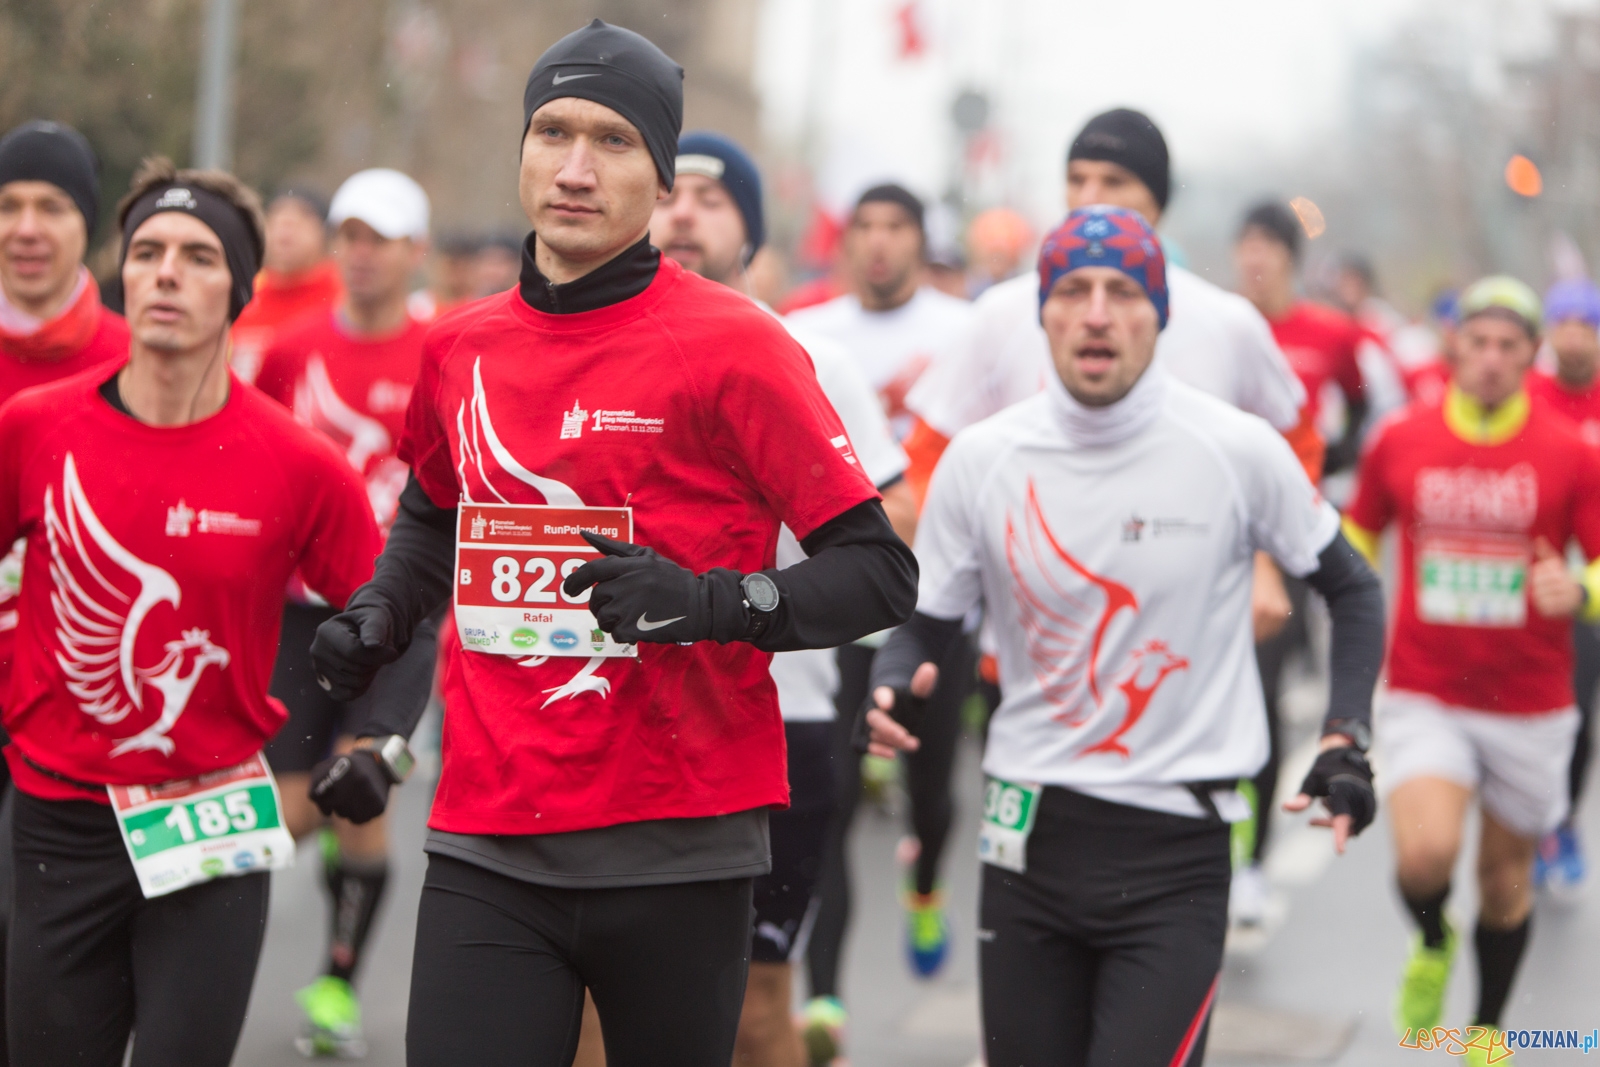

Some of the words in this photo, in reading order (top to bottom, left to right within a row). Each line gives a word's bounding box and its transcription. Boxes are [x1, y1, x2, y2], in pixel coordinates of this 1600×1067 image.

[459, 568, 472, 585] B
[523, 612, 554, 623] Rafał
[464, 628, 486, 637] GRUPA
[165, 789, 258, 843] 185
